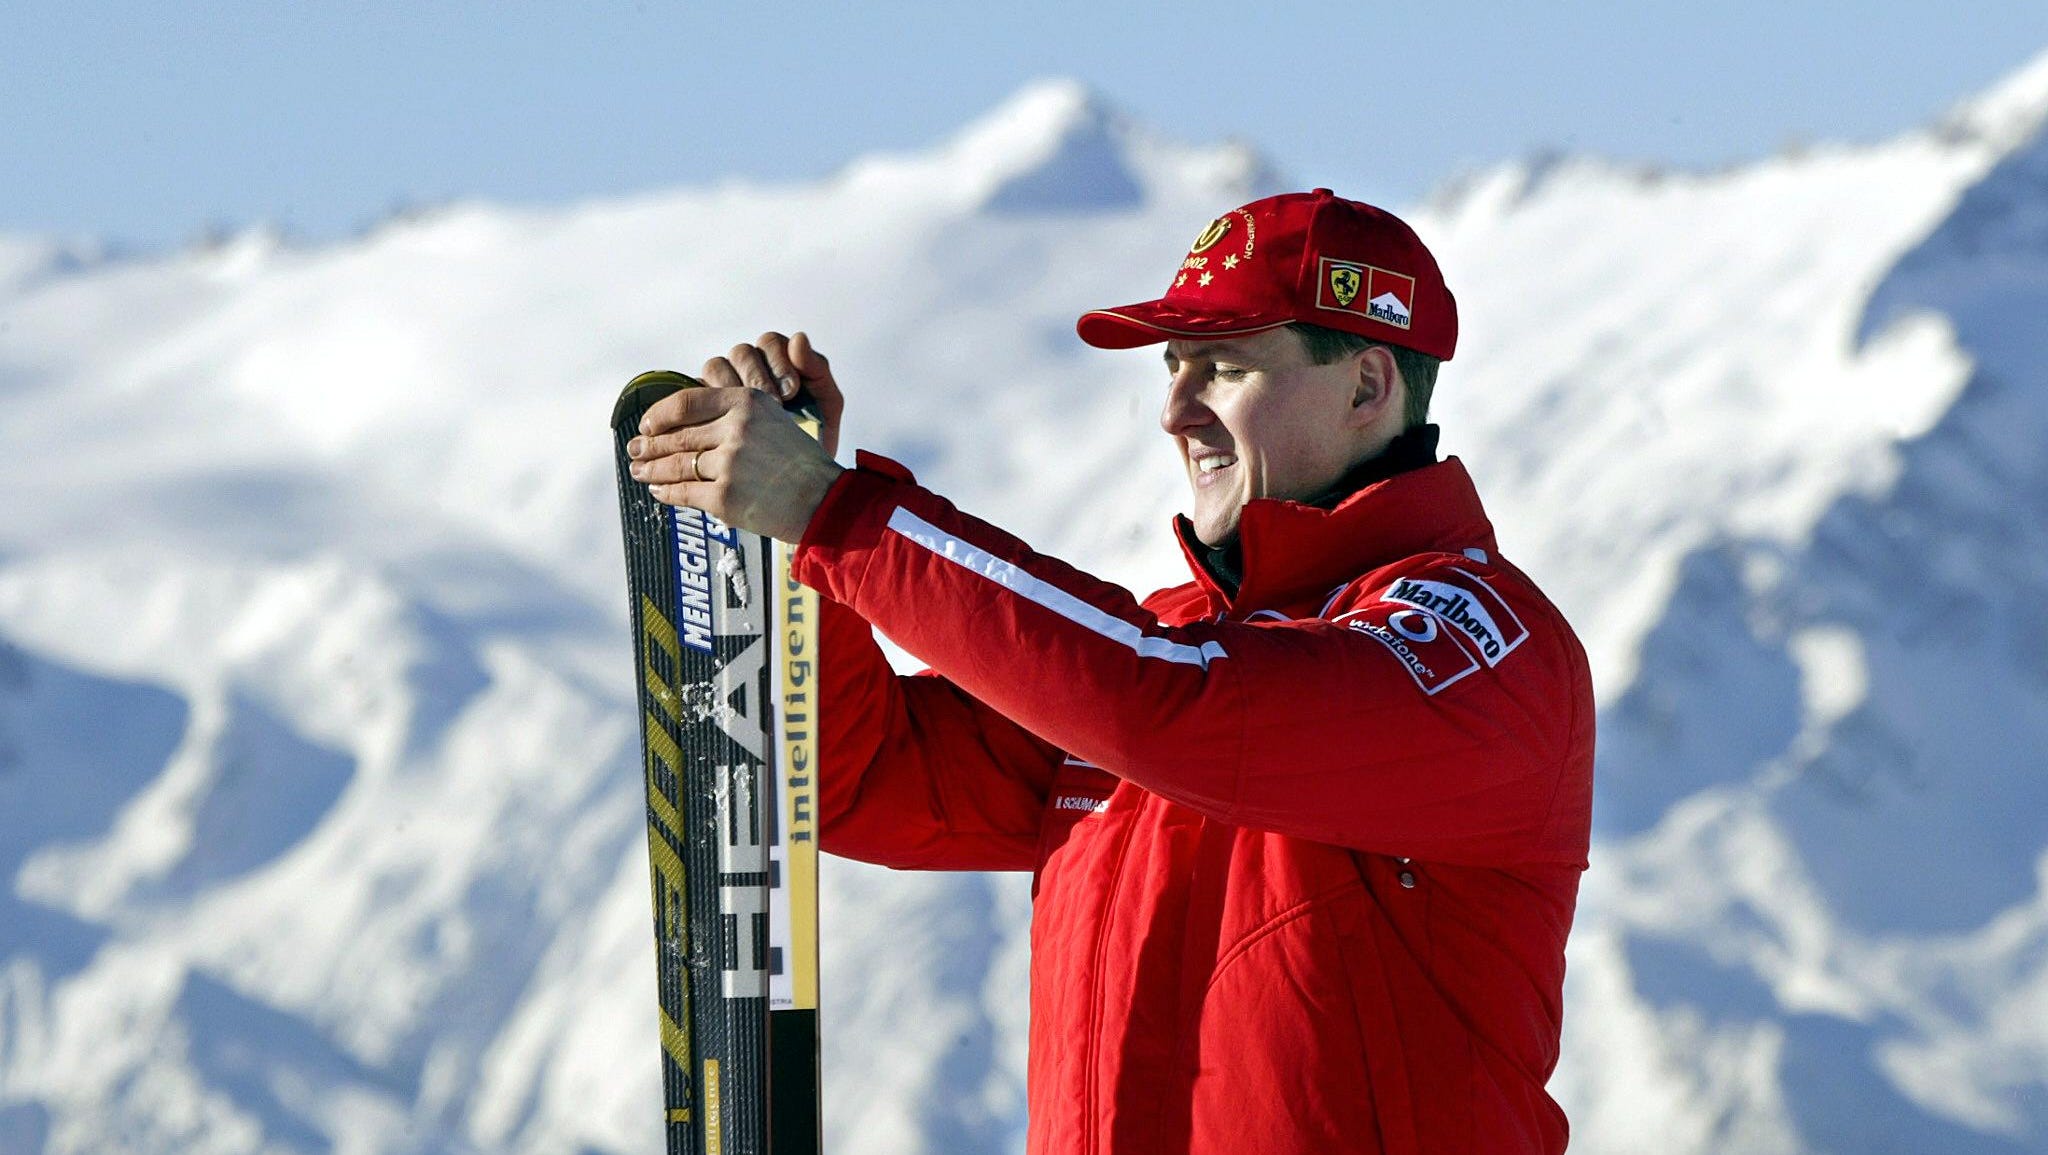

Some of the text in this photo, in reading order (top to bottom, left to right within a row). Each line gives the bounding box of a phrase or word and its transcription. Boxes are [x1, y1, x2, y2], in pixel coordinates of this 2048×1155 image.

[1369, 302, 1409, 326] Marlboro
[785, 545, 811, 844] intelligenc
[1388, 581, 1501, 659] Marlboro
[707, 527, 768, 999] HEAD
